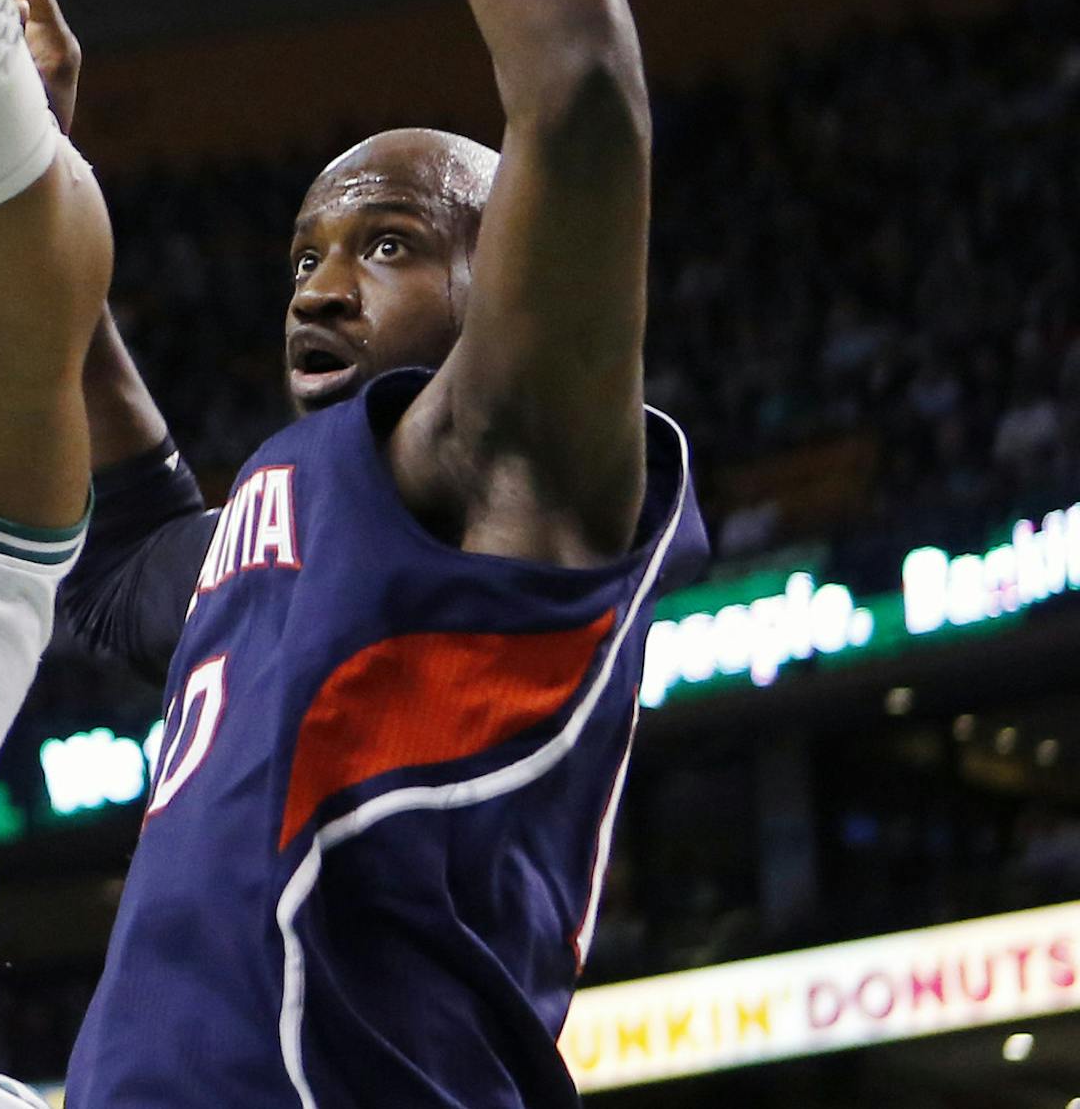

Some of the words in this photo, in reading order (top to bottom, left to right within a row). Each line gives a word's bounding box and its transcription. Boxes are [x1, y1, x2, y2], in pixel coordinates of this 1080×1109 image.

[146, 652, 229, 814] 0
[570, 983, 792, 1074] UNKIN'
[806, 937, 1078, 1030] DONUTS
